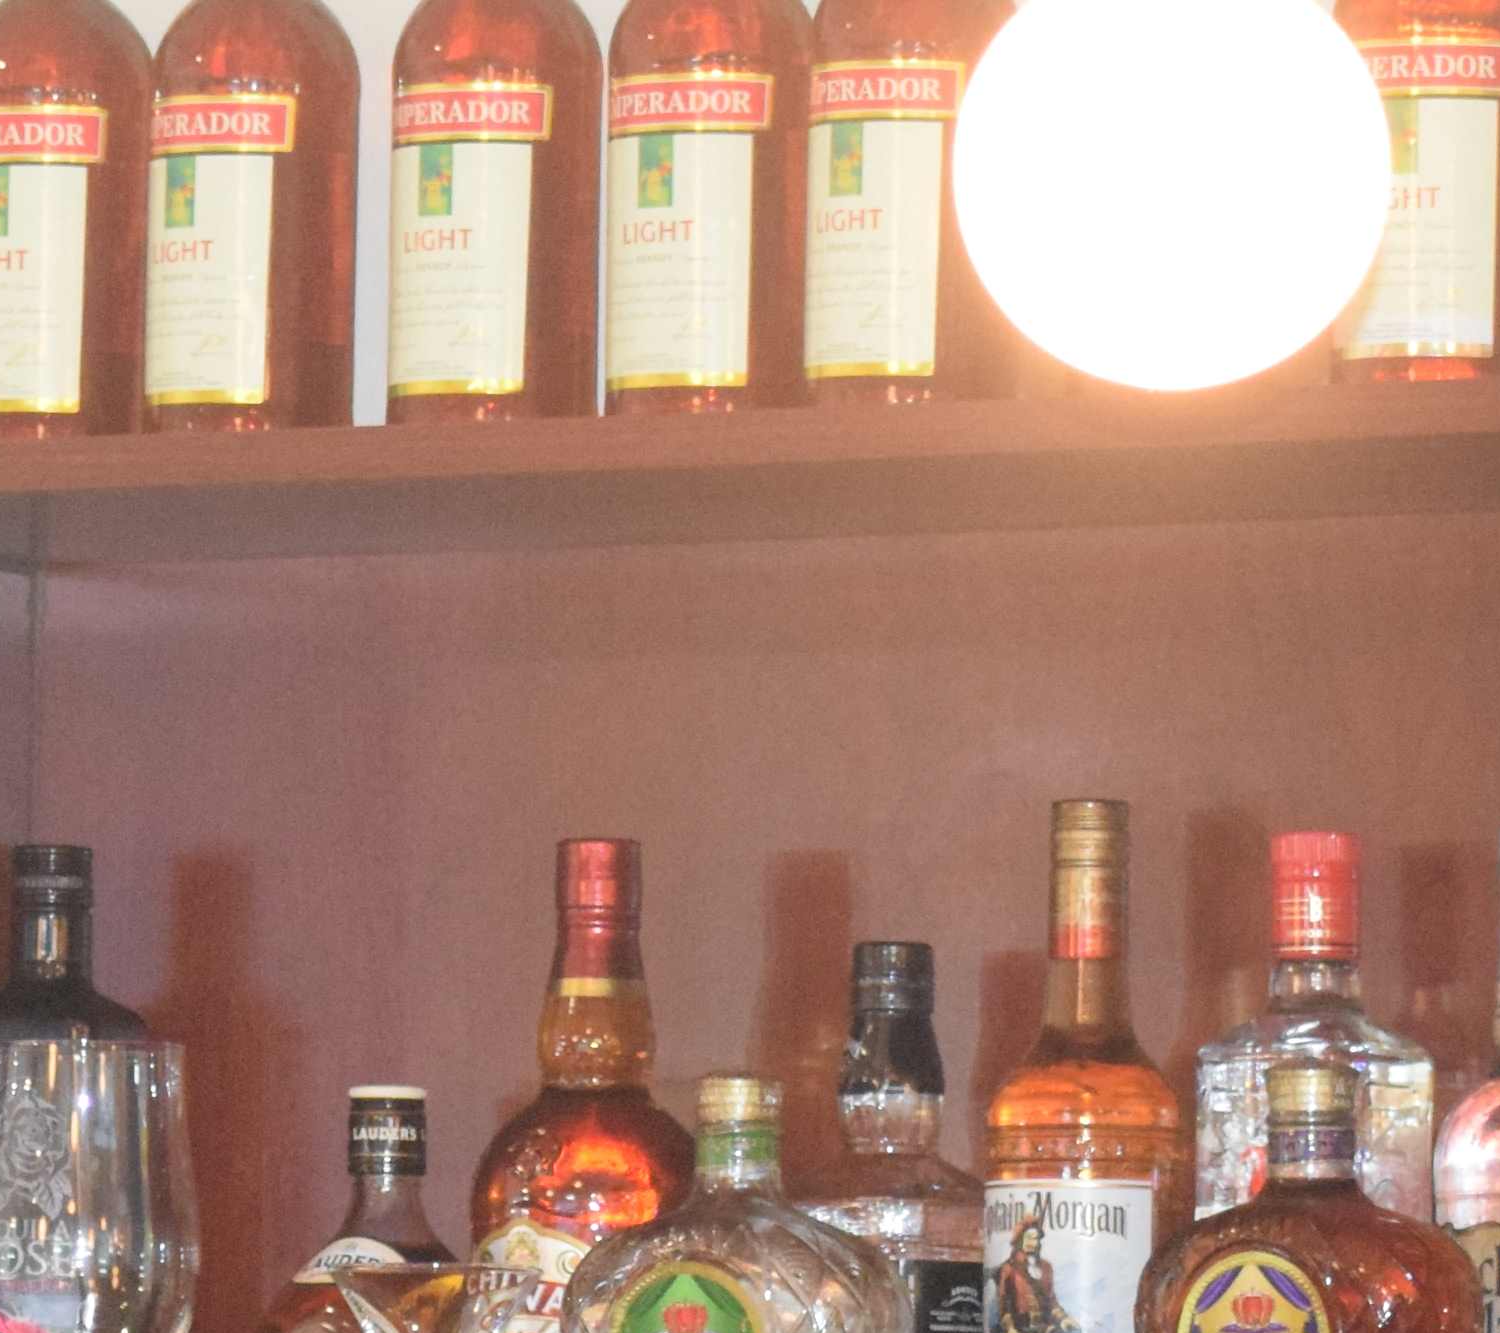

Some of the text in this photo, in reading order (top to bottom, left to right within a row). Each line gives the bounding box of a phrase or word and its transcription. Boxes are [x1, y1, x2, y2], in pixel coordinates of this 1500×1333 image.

[622, 219, 694, 246] LIGHT
[816, 208, 883, 234] LIGHT
[153, 240, 215, 264] LIGHT
[403, 228, 473, 254] LIGHT
[1028, 1191, 1128, 1239] Morgan
